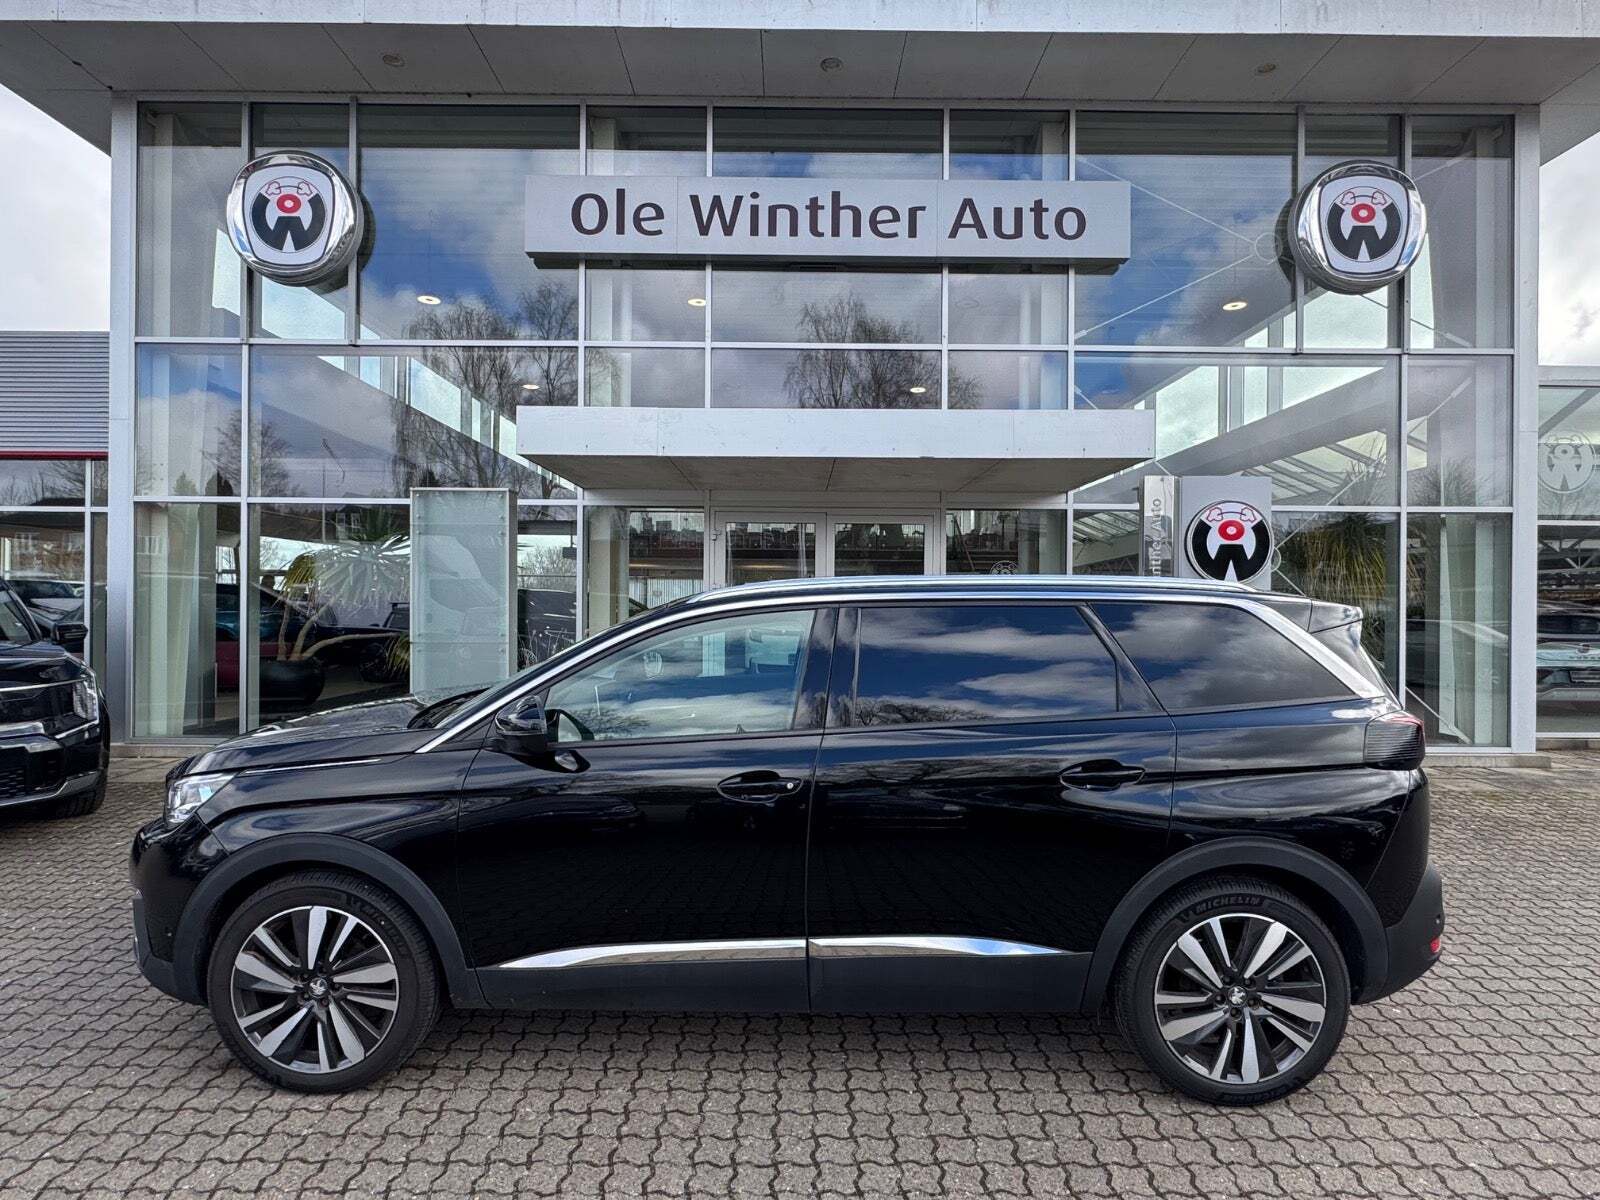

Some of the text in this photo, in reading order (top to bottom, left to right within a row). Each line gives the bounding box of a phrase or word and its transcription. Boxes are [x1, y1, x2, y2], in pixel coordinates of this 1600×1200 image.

[571, 188, 1087, 240] Ole Winther Auto
[1150, 498, 1162, 575] nther Auto
[1196, 896, 1261, 913] MICHELIN
